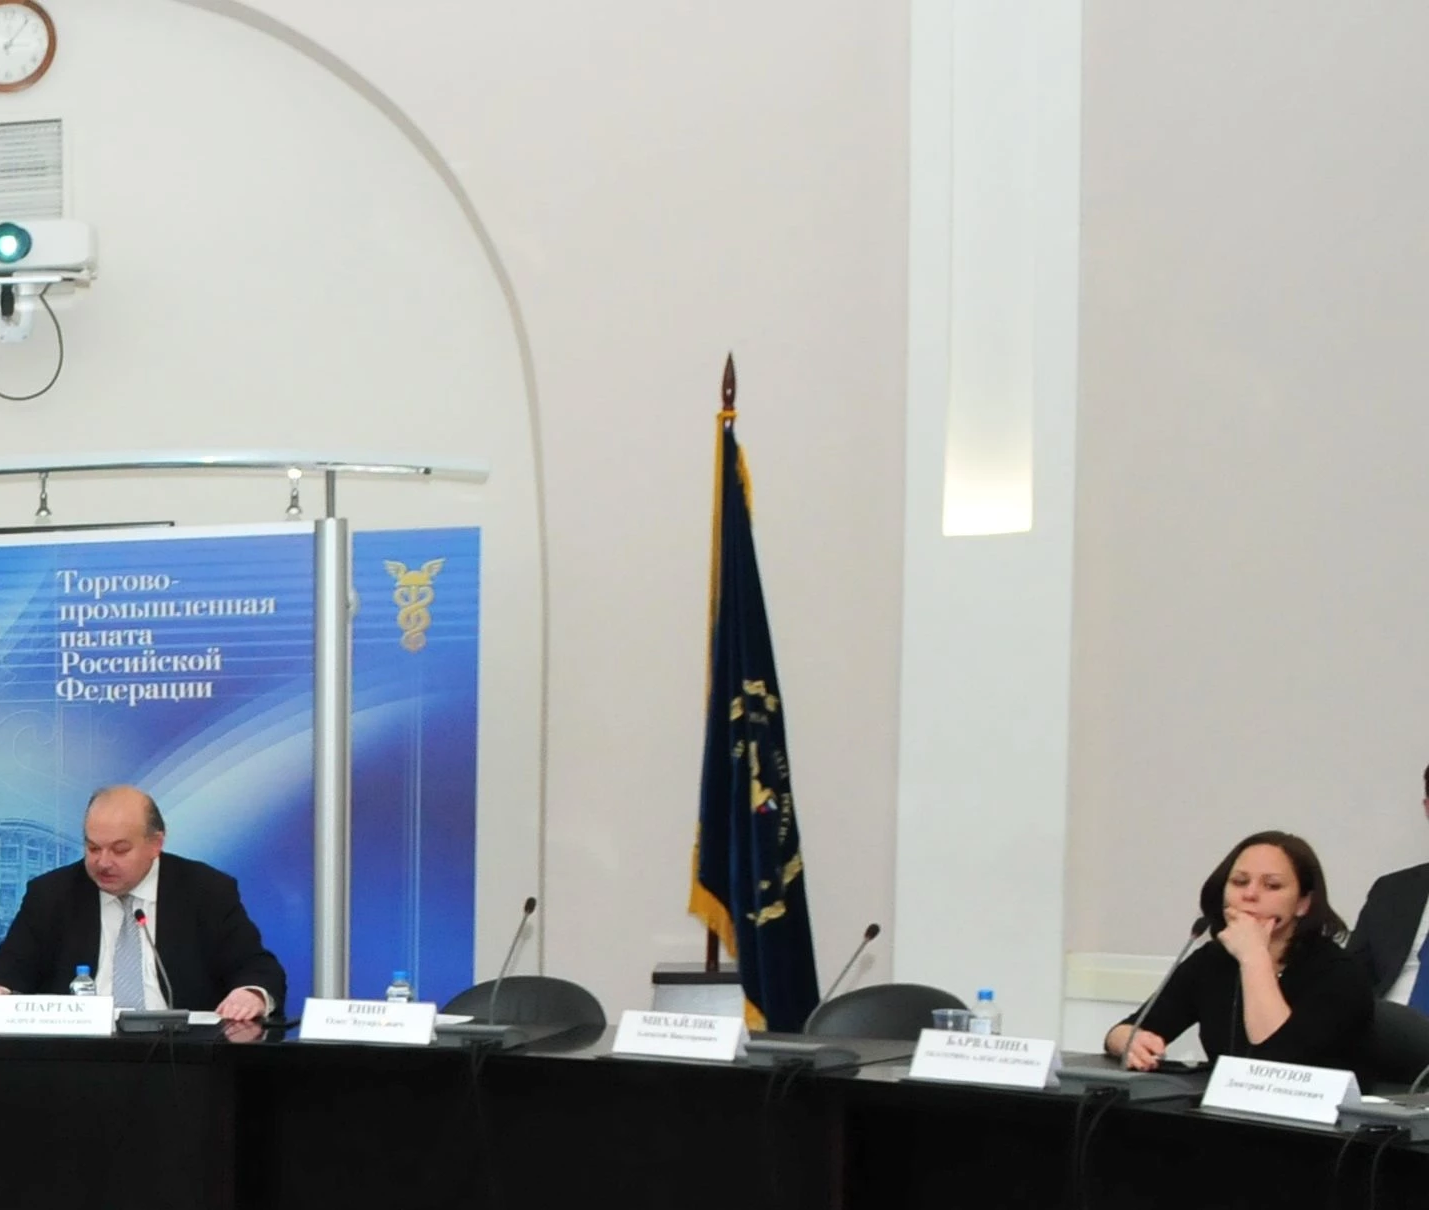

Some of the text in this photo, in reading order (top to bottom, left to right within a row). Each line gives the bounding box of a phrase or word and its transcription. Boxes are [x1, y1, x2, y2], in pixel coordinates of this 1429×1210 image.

[56, 570, 181, 599] Торгово-
[59, 597, 276, 627] промышленная
[59, 629, 153, 648] палата
[60, 646, 222, 675] Российской
[55, 677, 213, 707] Федерации
[14, 1002, 86, 1013] СПАРТАК
[1247, 1064, 1313, 1084] МОРОЗОВ
